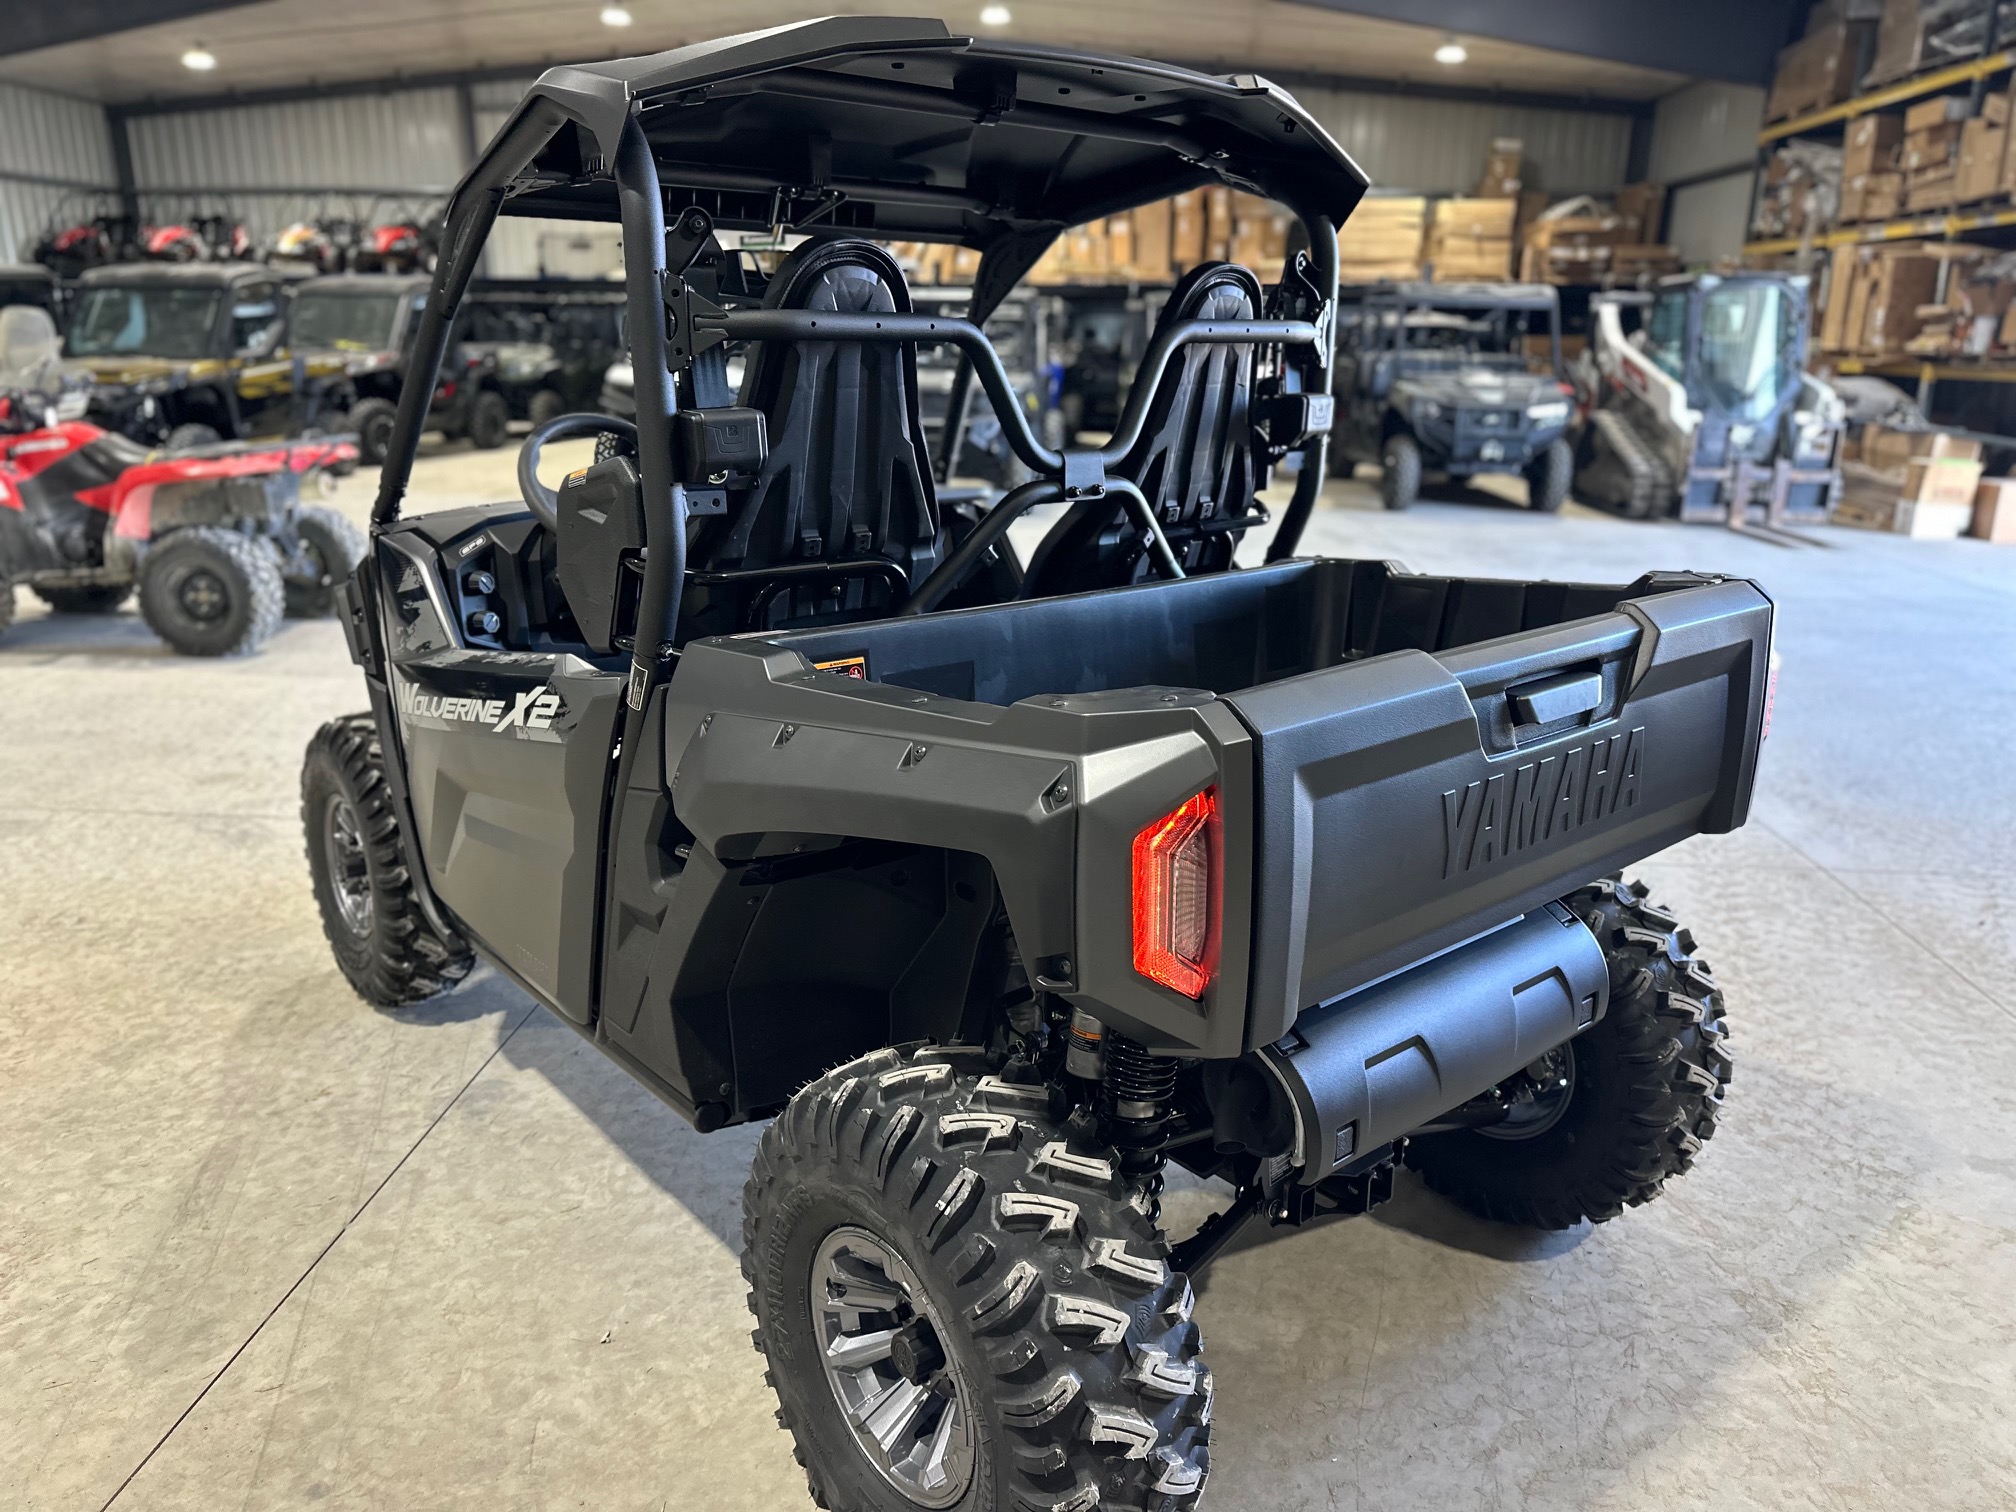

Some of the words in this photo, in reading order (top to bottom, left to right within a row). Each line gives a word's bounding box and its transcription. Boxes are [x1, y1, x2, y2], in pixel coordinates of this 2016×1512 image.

[399, 683, 506, 724] WOLVERINE
[492, 686, 560, 732] X2
[1442, 726, 1645, 880] YAMAHA
